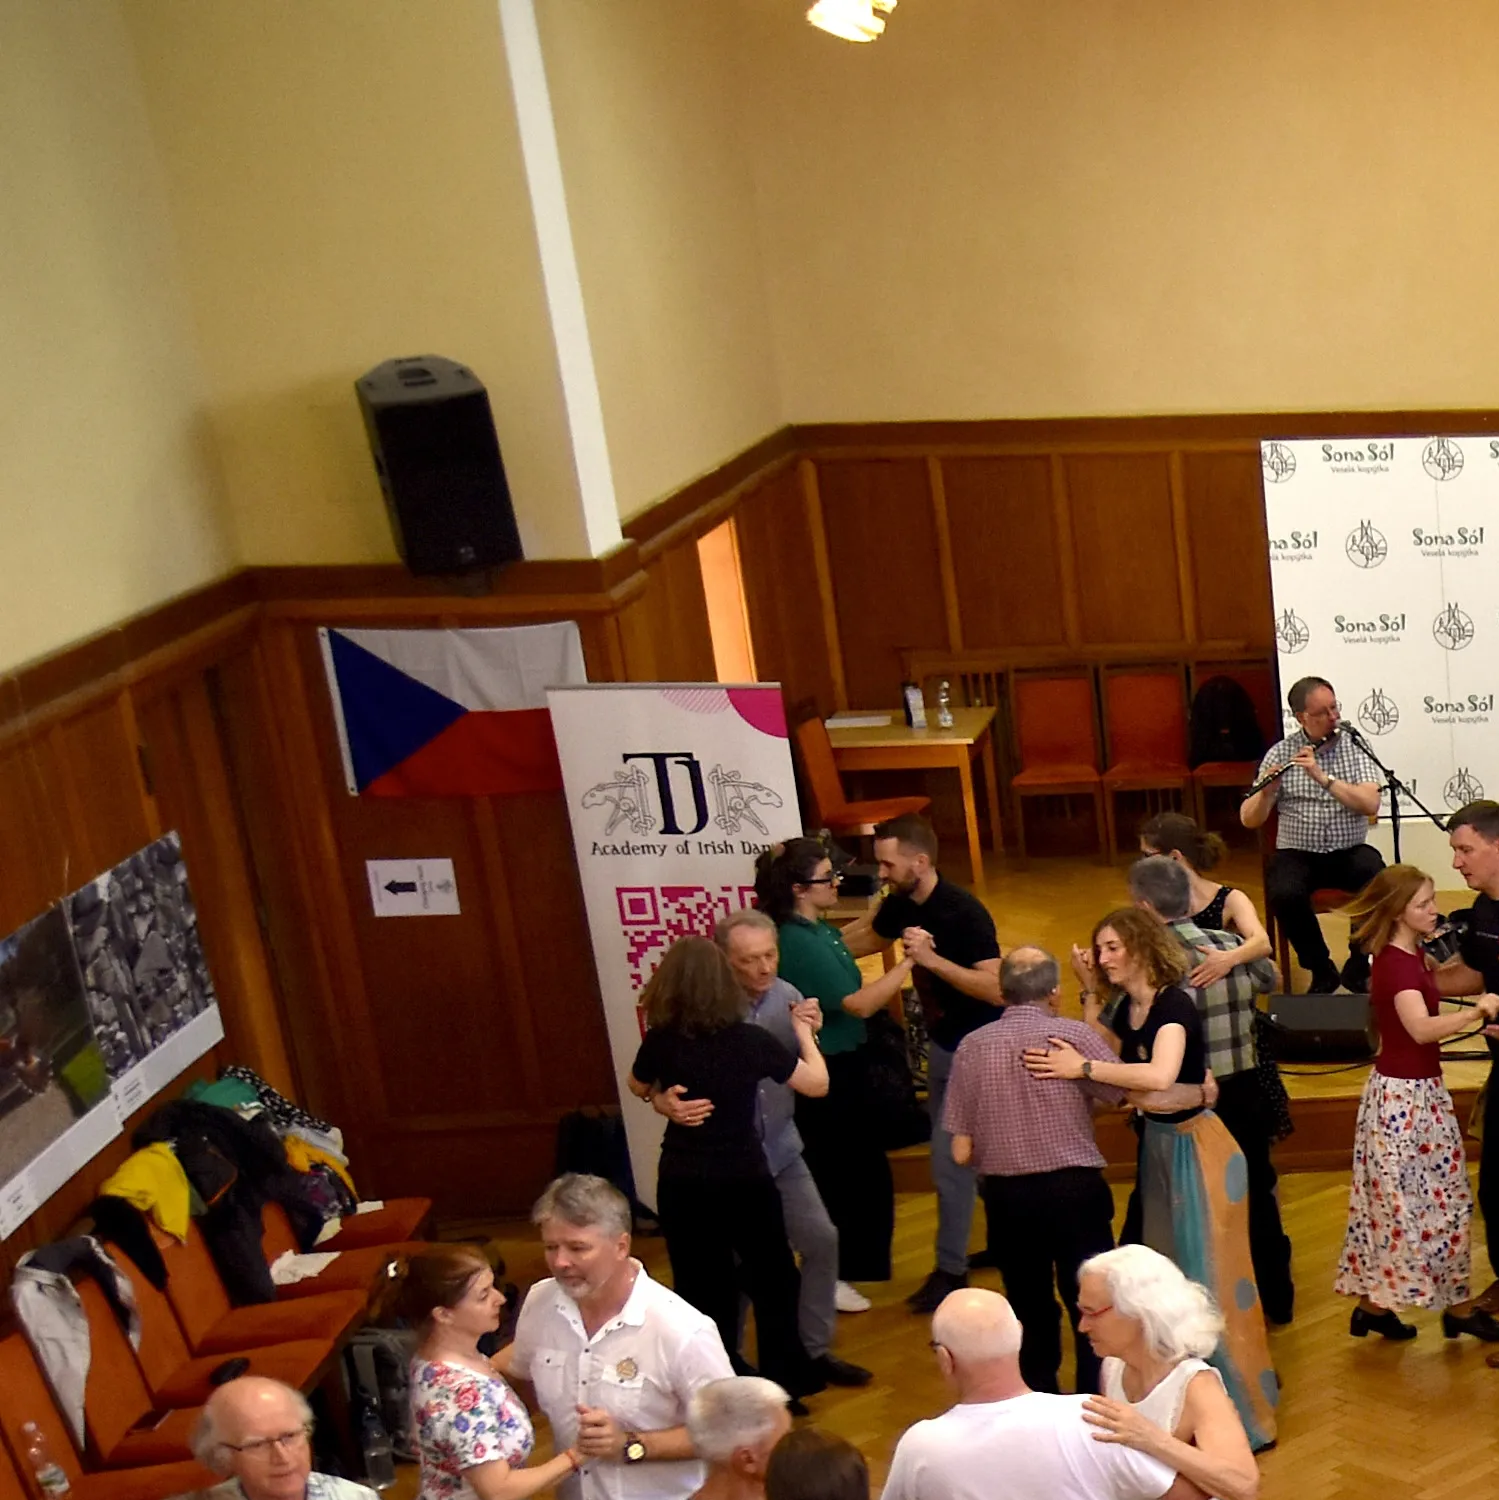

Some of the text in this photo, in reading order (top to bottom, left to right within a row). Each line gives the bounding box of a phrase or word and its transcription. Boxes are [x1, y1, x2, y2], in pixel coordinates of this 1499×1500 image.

[1322, 443, 1394, 462] Sona Sól
[1291, 532, 1318, 549] Sól
[1412, 527, 1483, 546] Sona Sól
[1335, 614, 1405, 633] Sona Sól
[1424, 695, 1493, 713] Sona Sól
[592, 841, 667, 856] Academy
[676, 840, 689, 854] of
[699, 840, 733, 854] Irish
